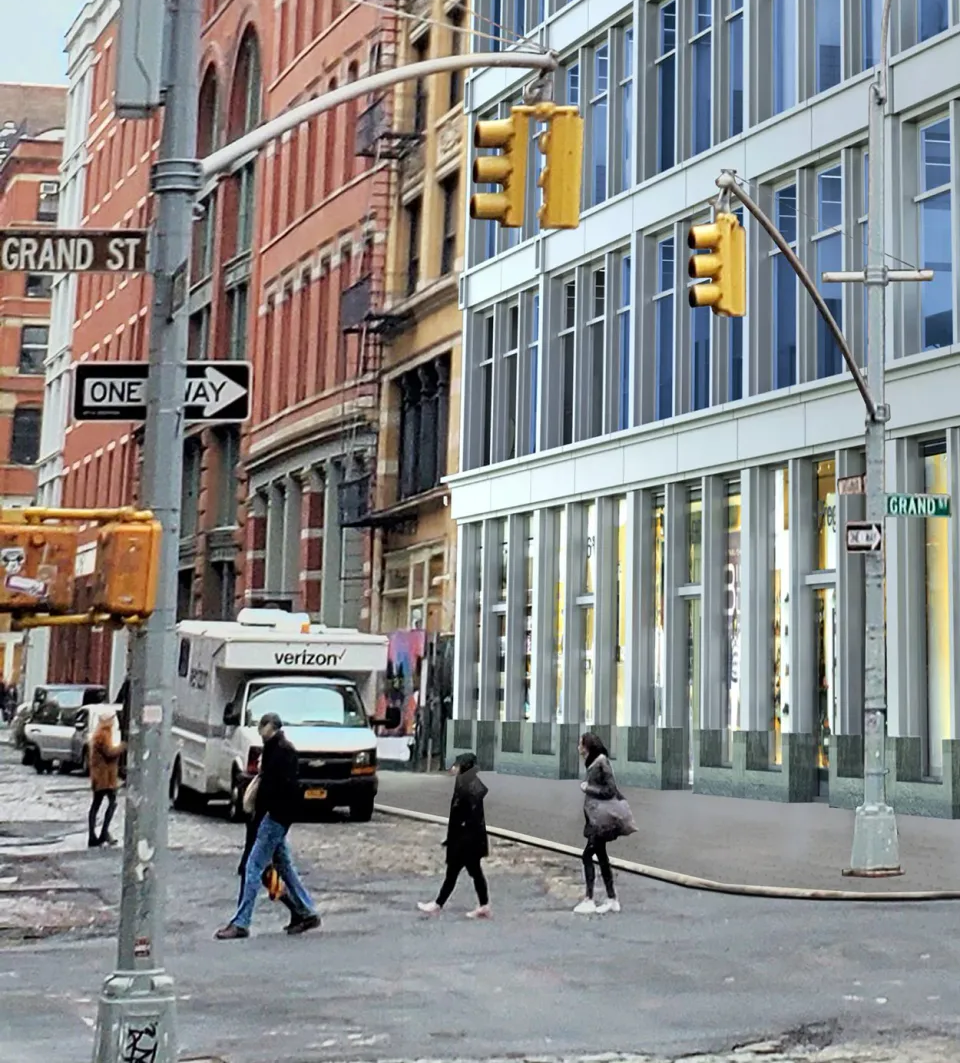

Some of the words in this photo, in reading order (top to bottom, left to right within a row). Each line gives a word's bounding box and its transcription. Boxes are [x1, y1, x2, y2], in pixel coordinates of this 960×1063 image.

[2, 237, 94, 270] GRAND
[106, 238, 140, 270] ST
[91, 381, 142, 402] ONE
[889, 497, 936, 515] GRAND
[275, 649, 338, 666] verizon
